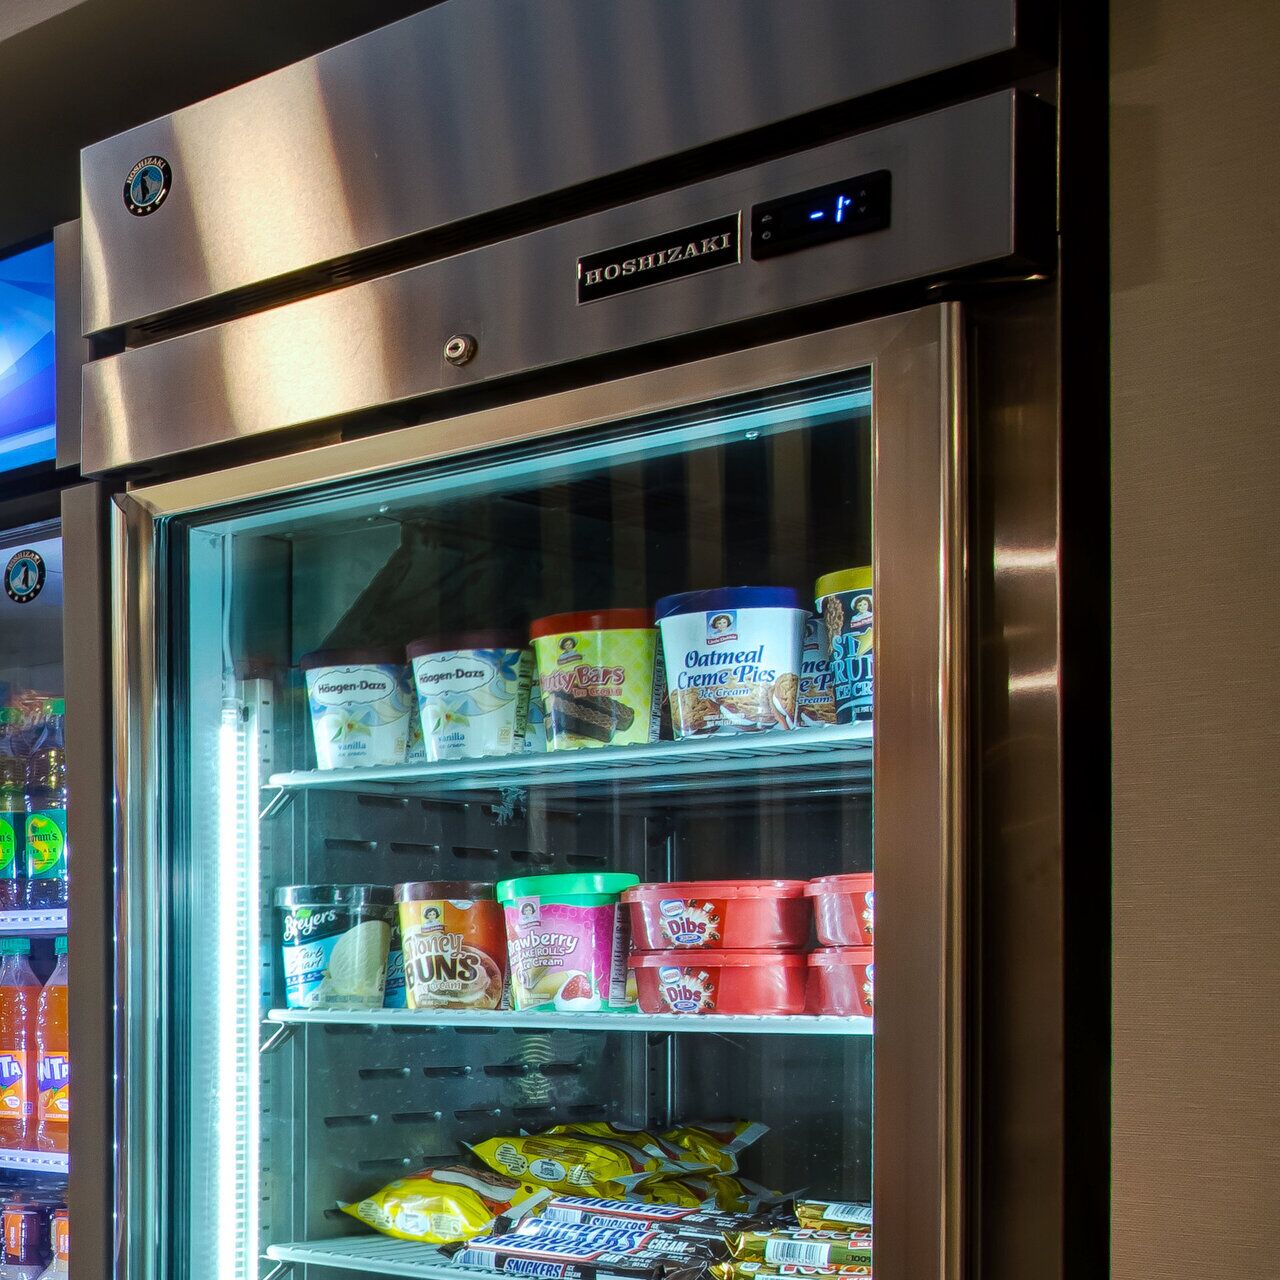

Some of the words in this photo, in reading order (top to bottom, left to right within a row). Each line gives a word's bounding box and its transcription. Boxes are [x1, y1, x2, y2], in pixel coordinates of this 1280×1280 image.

[126, 157, 166, 184] HOSHIZAKI
[585, 232, 731, 286] HOSHIZAKI
[684, 644, 764, 669] Oatmeal
[574, 664, 625, 688] Bars
[677, 671, 729, 692] Creme
[733, 665, 776, 686] Pies
[698, 690, 713, 699] Ice
[715, 687, 750, 698] Cream
[284, 907, 337, 942] Breyers
[668, 916, 707, 935] Dibs
[407, 933, 464, 958] Honey
[537, 947, 566, 957] ROLLS
[405, 954, 478, 990] BUNS
[532, 957, 563, 968] Cream
[666, 985, 702, 1003] Dibs
[647, 1239, 688, 1253] CREAM
[505, 1259, 563, 1279] SNICKERS
